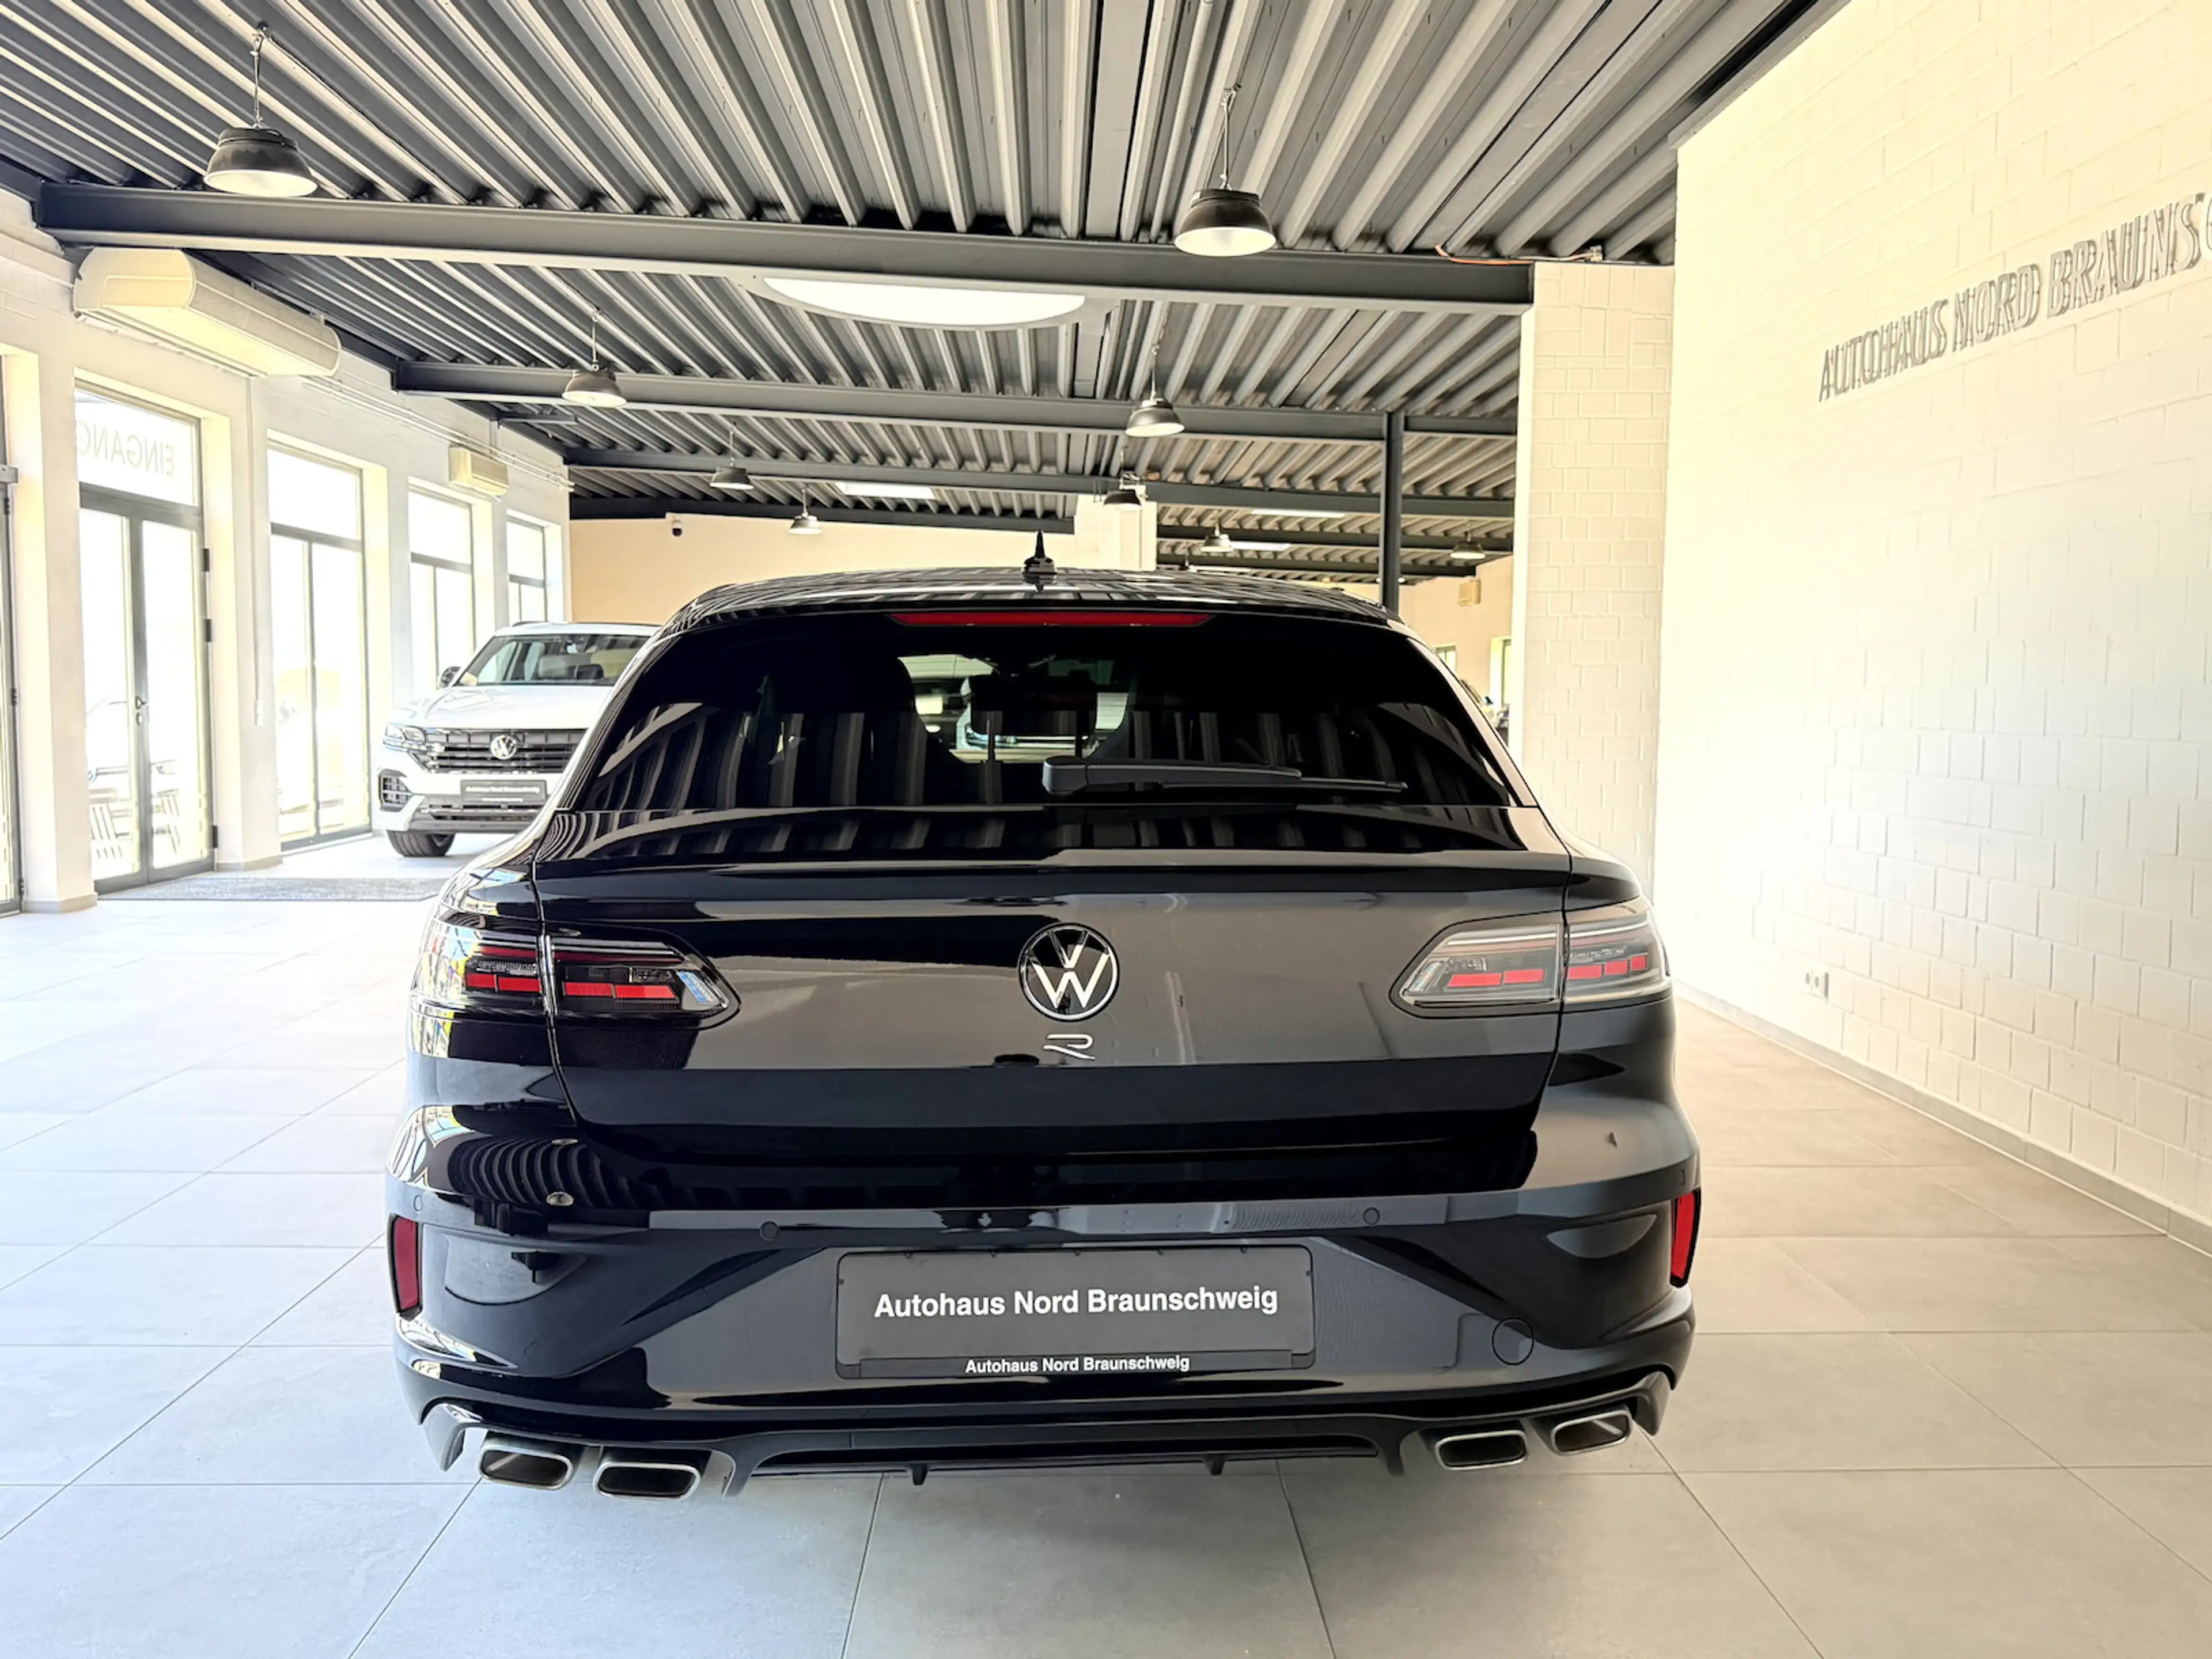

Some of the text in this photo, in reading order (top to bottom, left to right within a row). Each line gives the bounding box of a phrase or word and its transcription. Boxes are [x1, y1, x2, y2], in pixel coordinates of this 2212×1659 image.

[1819, 298, 1948, 402] AUTOHAUS
[1952, 263, 2041, 353] NORD
[1027, 927, 1112, 1009] VW
[1043, 1033, 1096, 1060] R
[874, 1285, 1278, 1317] Autohaus Nord Braunschweig
[965, 1355, 1190, 1373] Autohaus Nord Braunschweig
